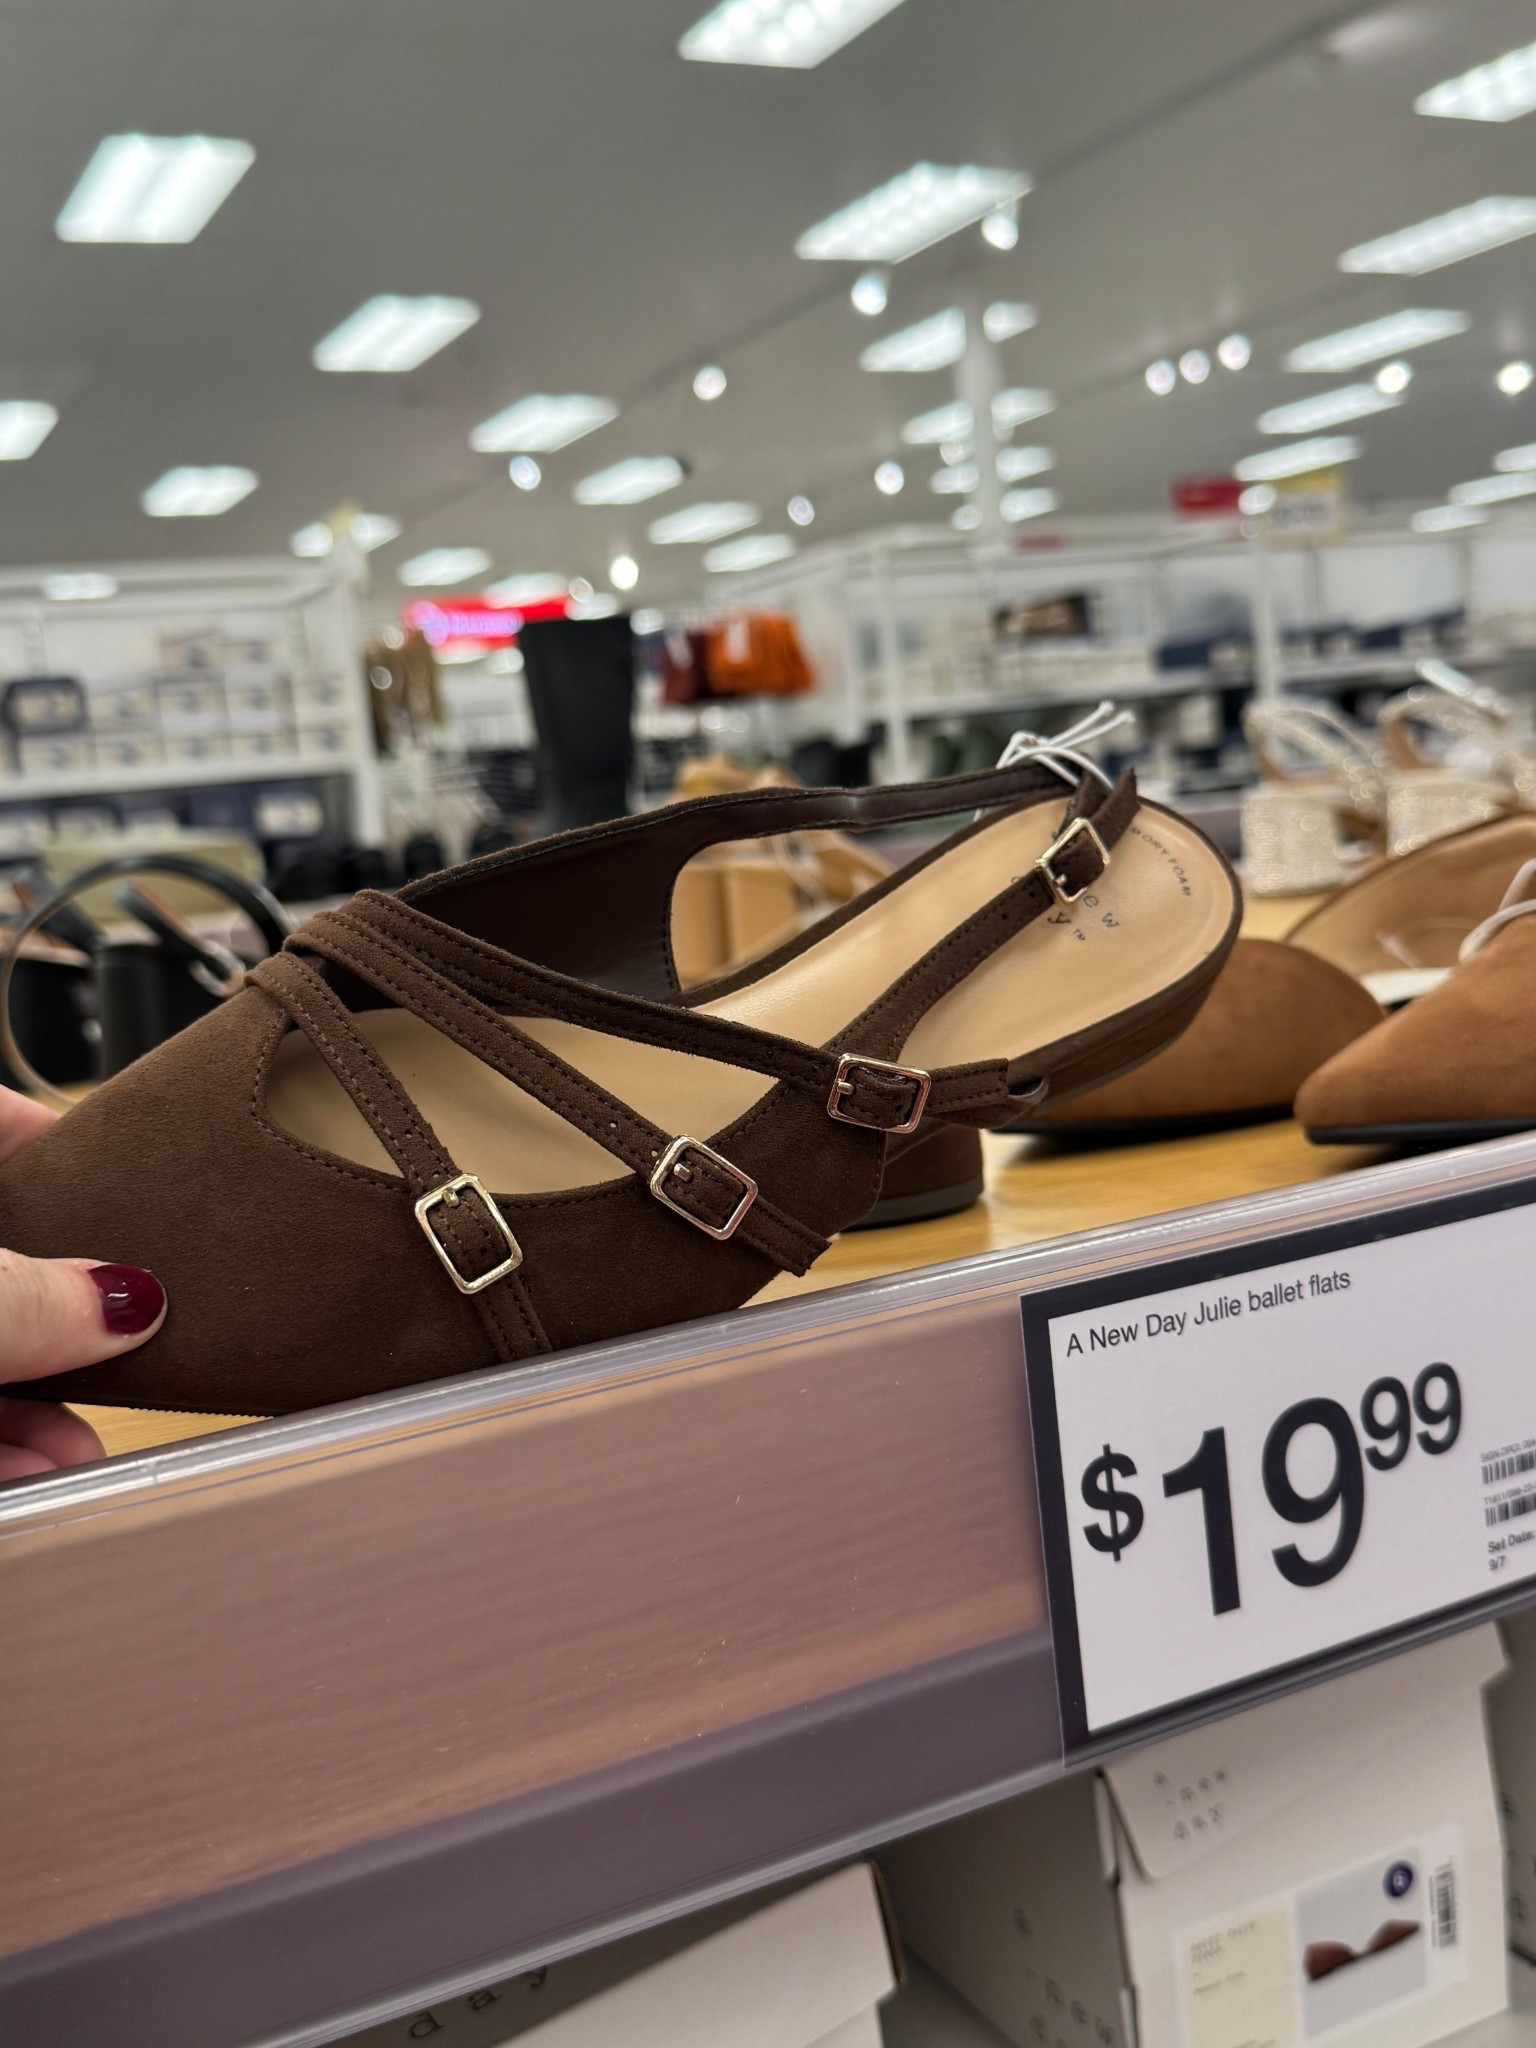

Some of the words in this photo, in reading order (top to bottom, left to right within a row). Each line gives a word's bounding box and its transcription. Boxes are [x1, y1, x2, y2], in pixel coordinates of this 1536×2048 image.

[1130, 827, 1169, 855] MORY
[1168, 859, 1191, 896] FOAM
[1067, 1333, 1084, 1357] A
[1090, 1323, 1138, 1351] New
[1146, 1312, 1187, 1336] Day
[1194, 1296, 1242, 1325] Julie
[1248, 1280, 1304, 1312] ballet
[1309, 1270, 1351, 1297] flats
[1487, 1539, 1506, 1554] Set
